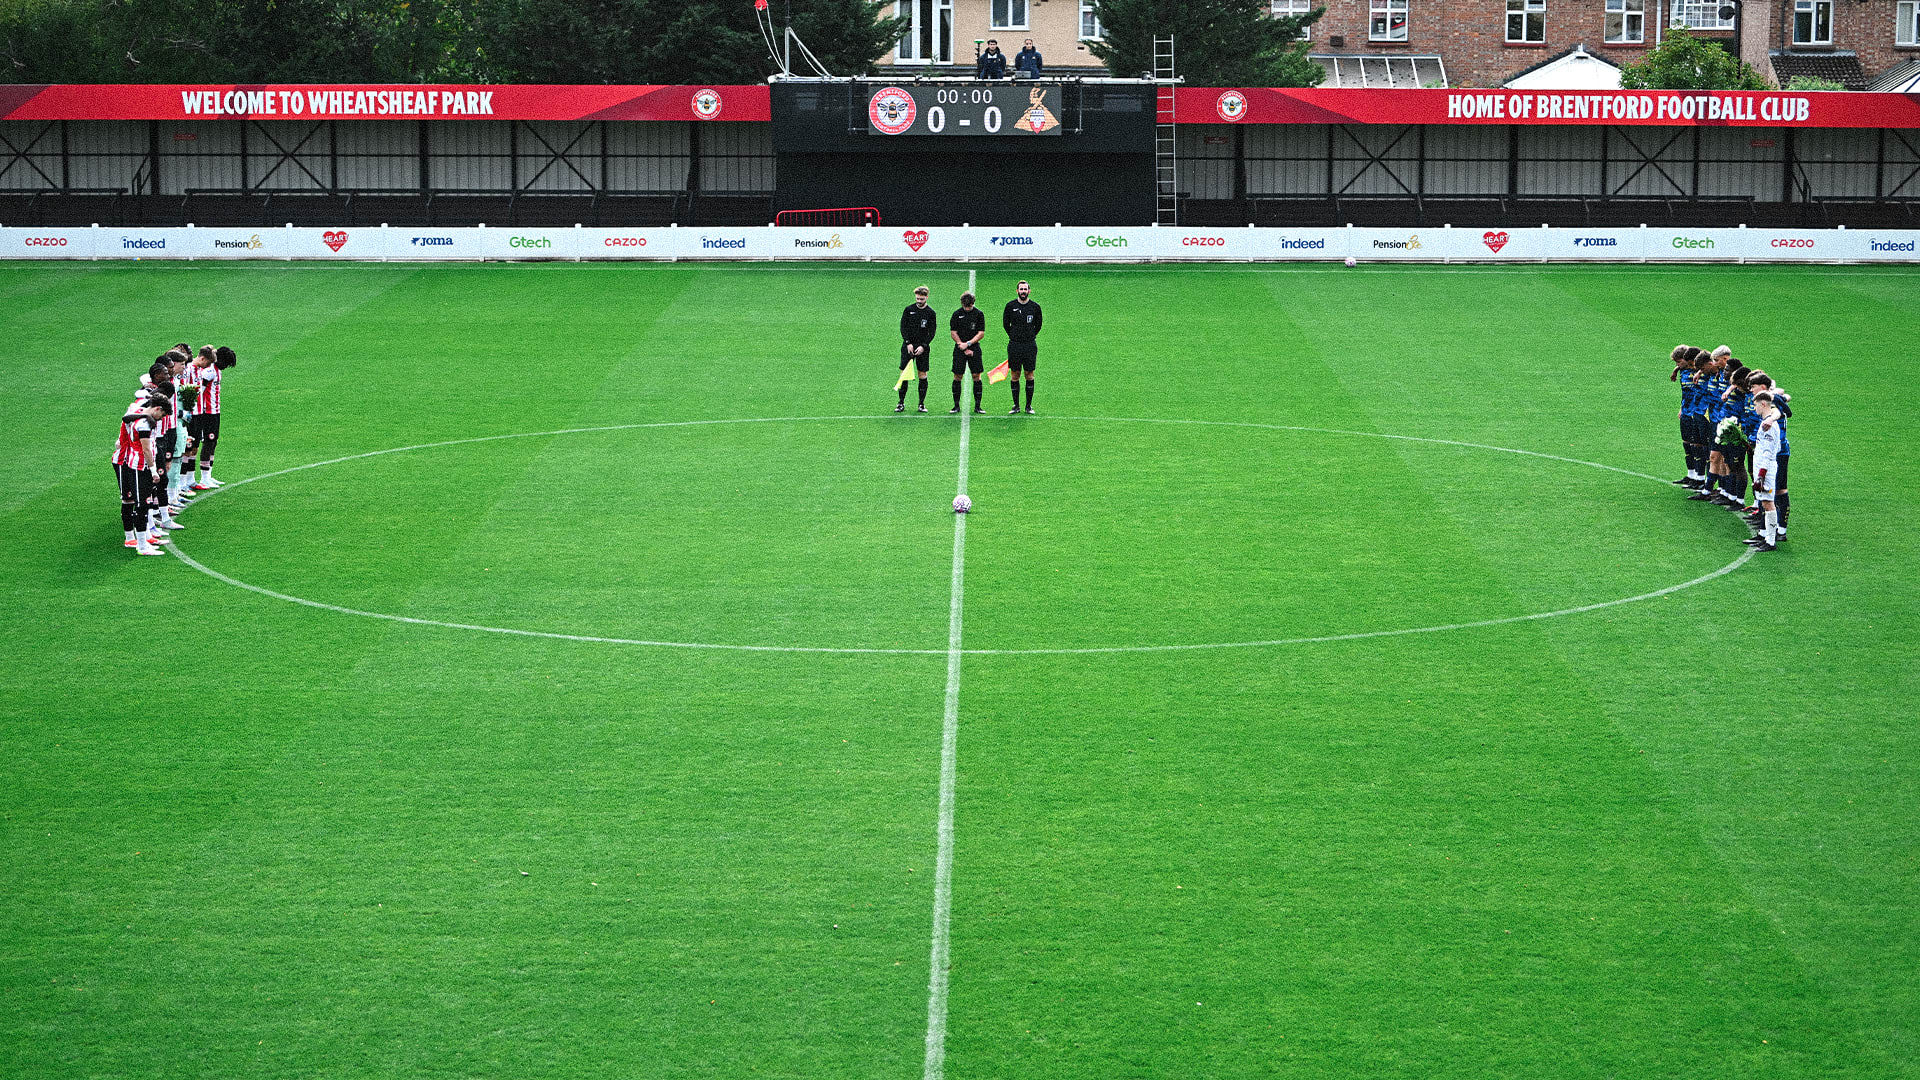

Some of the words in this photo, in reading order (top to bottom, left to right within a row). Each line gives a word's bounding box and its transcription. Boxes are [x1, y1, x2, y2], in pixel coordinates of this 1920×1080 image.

[181, 91, 277, 115] WELCOME
[279, 91, 305, 115] TO
[307, 91, 439, 115] WHEATSHEAF
[442, 91, 494, 115] PARK
[937, 89, 993, 104] 00:00
[1447, 94, 1505, 119] HOME
[1508, 94, 1534, 119] OF
[1536, 95, 1654, 120] BRENTFORD
[1656, 95, 1758, 121] FOOTBALL
[1760, 96, 1810, 122] CLUB
[927, 105, 946, 133] 0
[983, 105, 1002, 133] 0
[25, 237, 68, 247] CAZOO
[121, 236, 166, 249] indeed
[509, 236, 552, 249] Gtech
[605, 237, 648, 247] CAZOO
[701, 236, 746, 249] indeed
[1086, 235, 1129, 248] Gtech
[1183, 237, 1226, 247] CAZOO
[1280, 236, 1325, 249] indeed
[1672, 236, 1716, 249] Gtech
[1771, 238, 1815, 248] CAZOO
[1870, 238, 1916, 252] indeed
